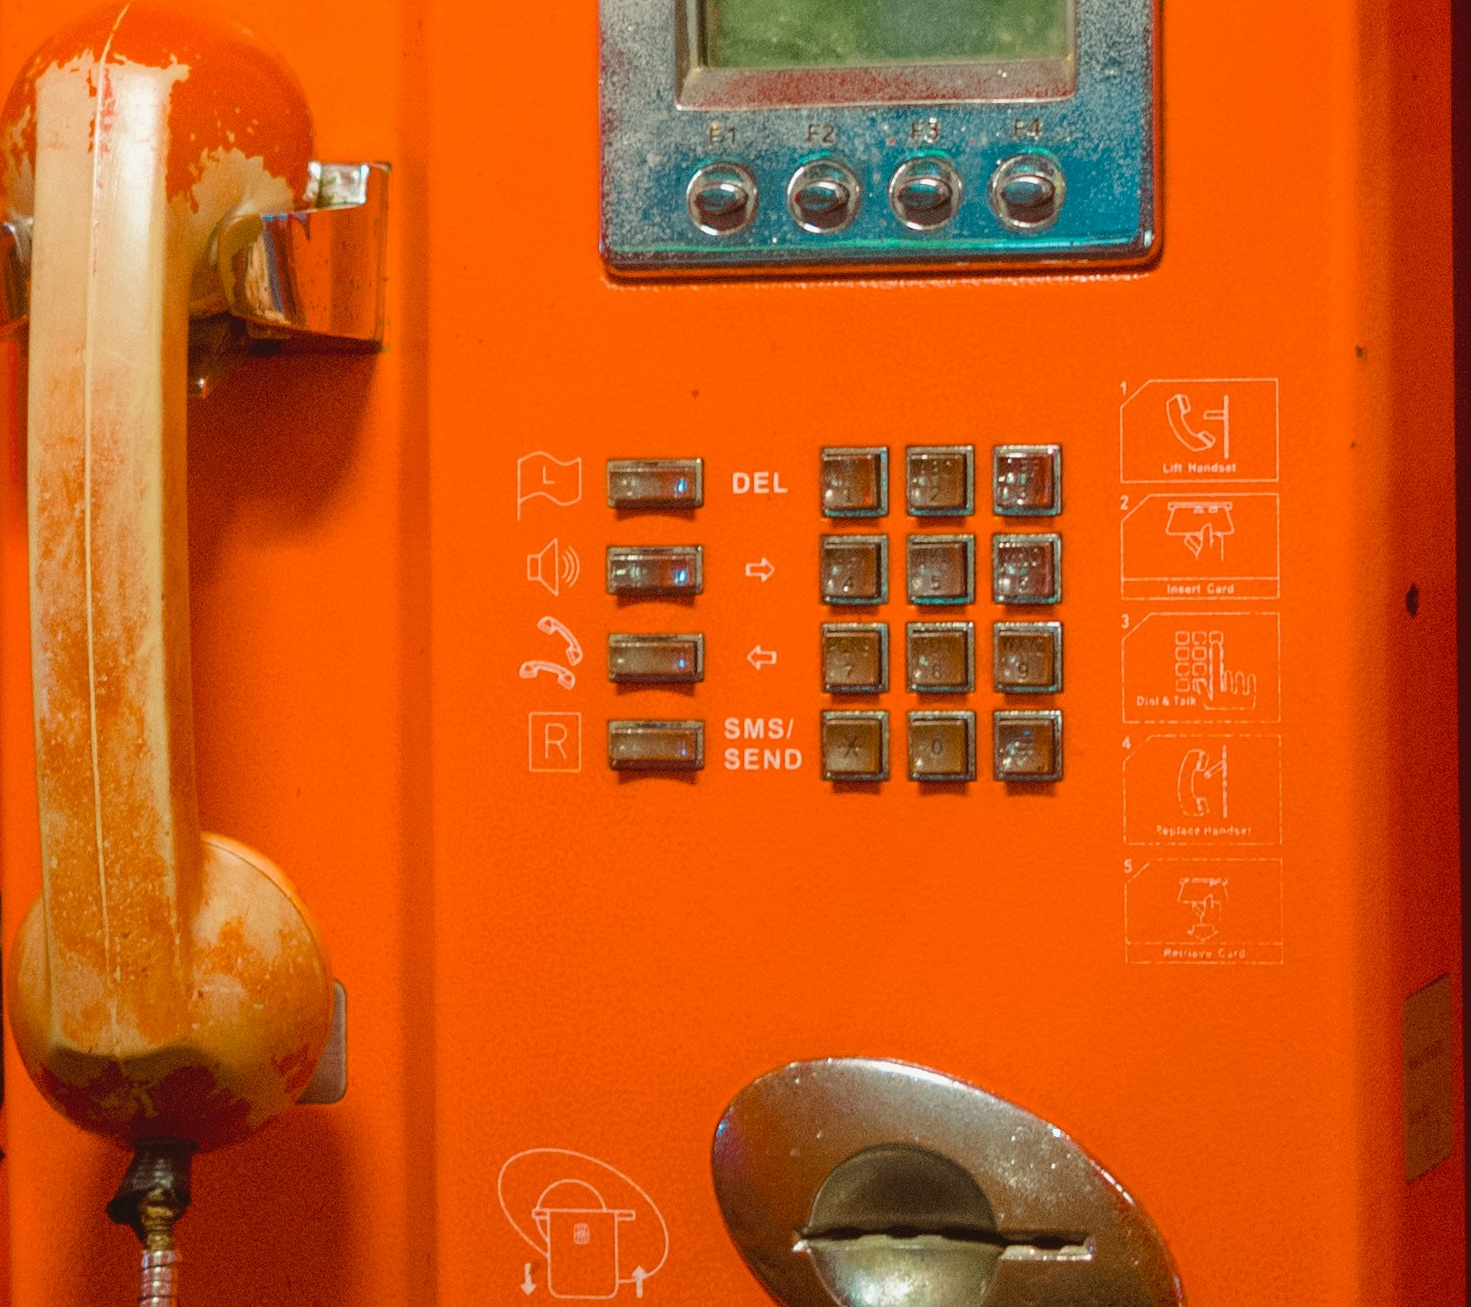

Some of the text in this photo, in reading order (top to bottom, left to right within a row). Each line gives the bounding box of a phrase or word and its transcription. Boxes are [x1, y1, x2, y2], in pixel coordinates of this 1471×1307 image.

[805, 123, 835, 143] F2
[911, 117, 940, 144] F3
[1014, 118, 1042, 140] F4
[1120, 380, 1127, 395] 1
[1163, 462, 1237, 474] Lift Handset
[732, 471, 789, 494] DEL
[1120, 495, 1129, 510] 2
[1166, 582, 1235, 595] Insert Card
[1121, 613, 1130, 629] 3
[1136, 695, 1197, 706] Dial & Talk
[724, 717, 794, 739] SMS/
[545, 723, 568, 760] R
[1121, 735, 1131, 749] 4
[724, 748, 803, 770] SEND
[1123, 858, 1133, 873] 5
[1218, 947, 1246, 959] Card
